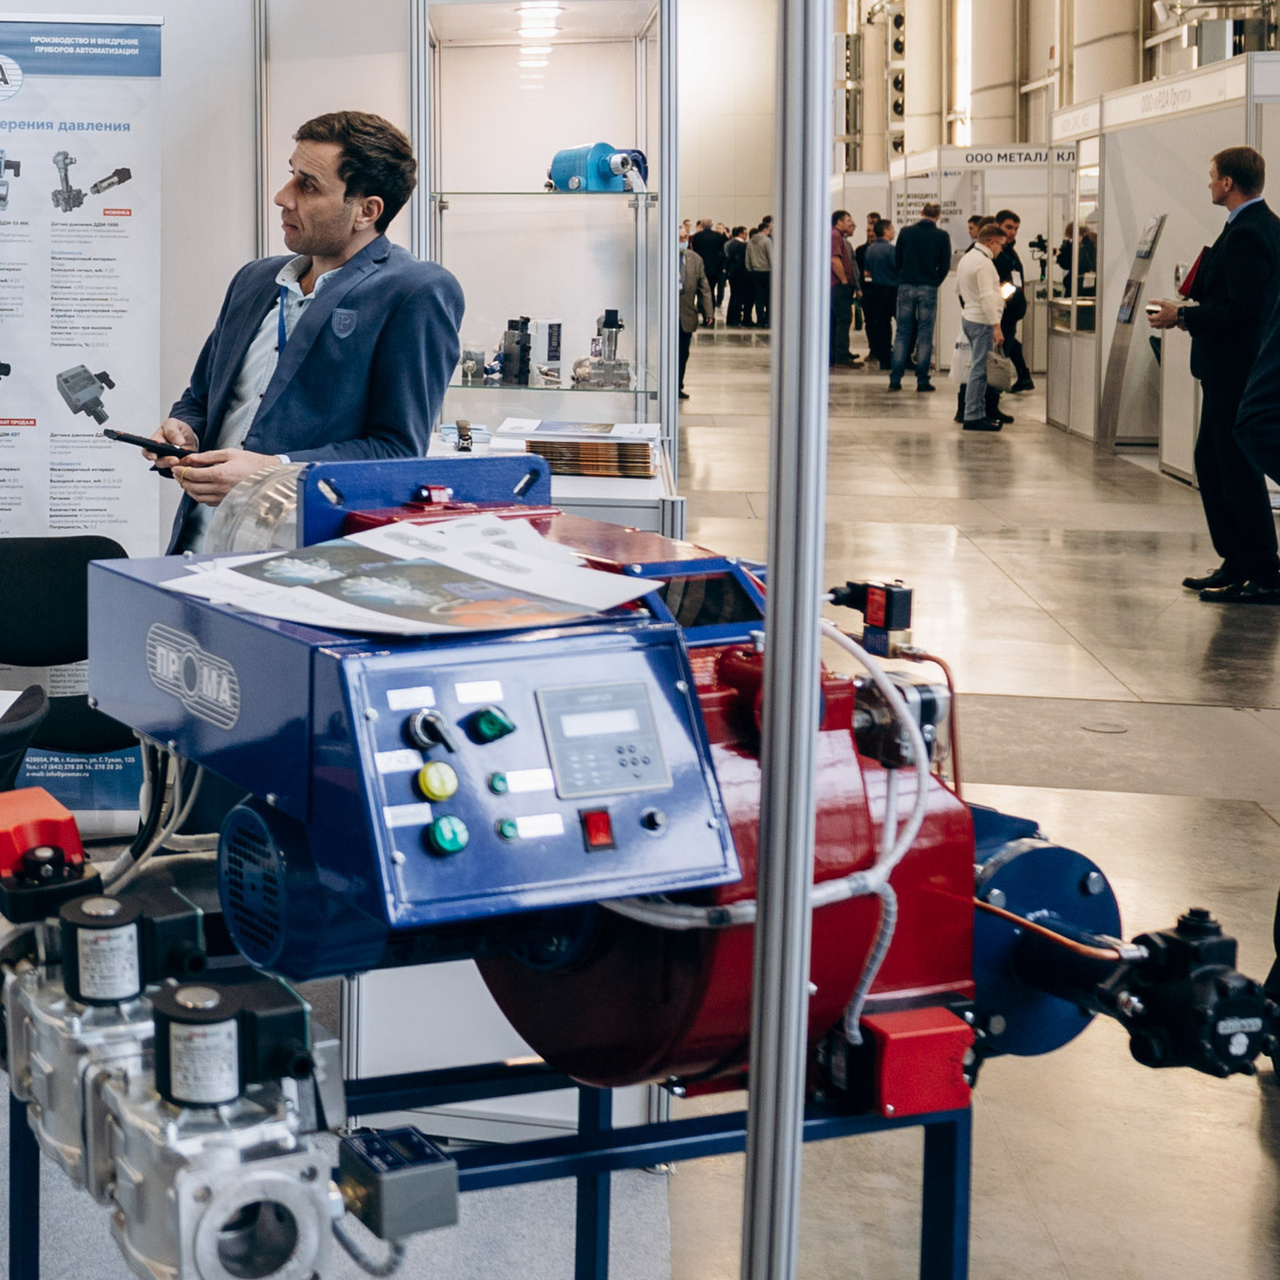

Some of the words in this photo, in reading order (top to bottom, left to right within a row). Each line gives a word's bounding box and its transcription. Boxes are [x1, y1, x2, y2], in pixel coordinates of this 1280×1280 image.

[30, 36, 90, 46] ПРОИЗВОДСТВО
[91, 37, 96, 45] И
[97, 37, 140, 46] ВНЕДРЕНИЕ
[34, 45, 75, 54] ПРИБОРОВ
[75, 46, 140, 56] АВТОМАТИЗАЦИИ
[57, 119, 131, 133] давления
[965, 152, 993, 164] ООО
[156, 645, 232, 707] ПРОМА
